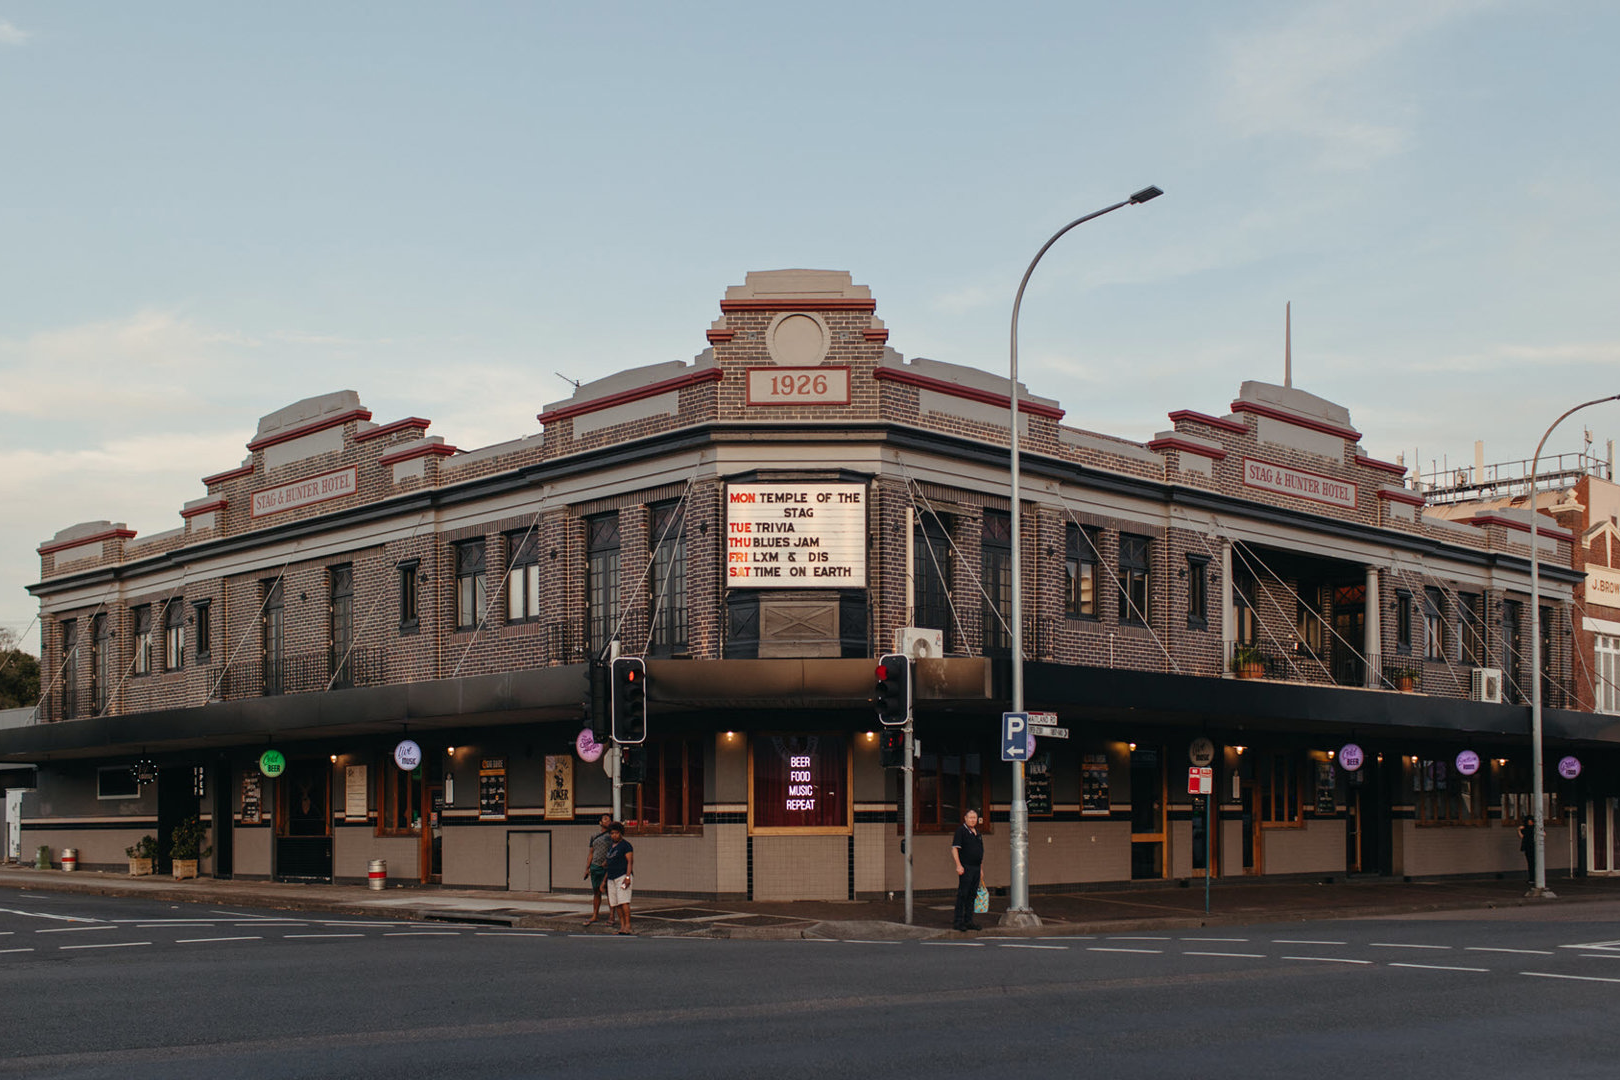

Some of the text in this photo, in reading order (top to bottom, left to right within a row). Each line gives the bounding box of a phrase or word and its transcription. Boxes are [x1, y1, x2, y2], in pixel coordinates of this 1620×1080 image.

[770, 374, 828, 396] 1926
[1249, 464, 1350, 500] STAG & HUNTER HOTEL
[256, 474, 350, 510] STAG & HUNTER HOTEL
[730, 493, 860, 503] MON TEMPLE OF THE
[784, 508, 814, 518] STAG
[729, 522, 795, 532] TUE TRIVIA
[728, 538, 820, 548] THU BLUES JAM
[729, 552, 829, 562] FRI LXM & DIS
[729, 567, 852, 577] SAT TIME ON EARTH
[1007, 717, 1025, 740] P
[398, 746, 413, 759] Live
[401, 757, 417, 765] MUSIC
[790, 756, 810, 768] BEER
[790, 771, 810, 782] FOOD
[550, 789, 569, 801] JOKER
[788, 785, 813, 796] MUSIC
[786, 800, 816, 810] REPEAT
